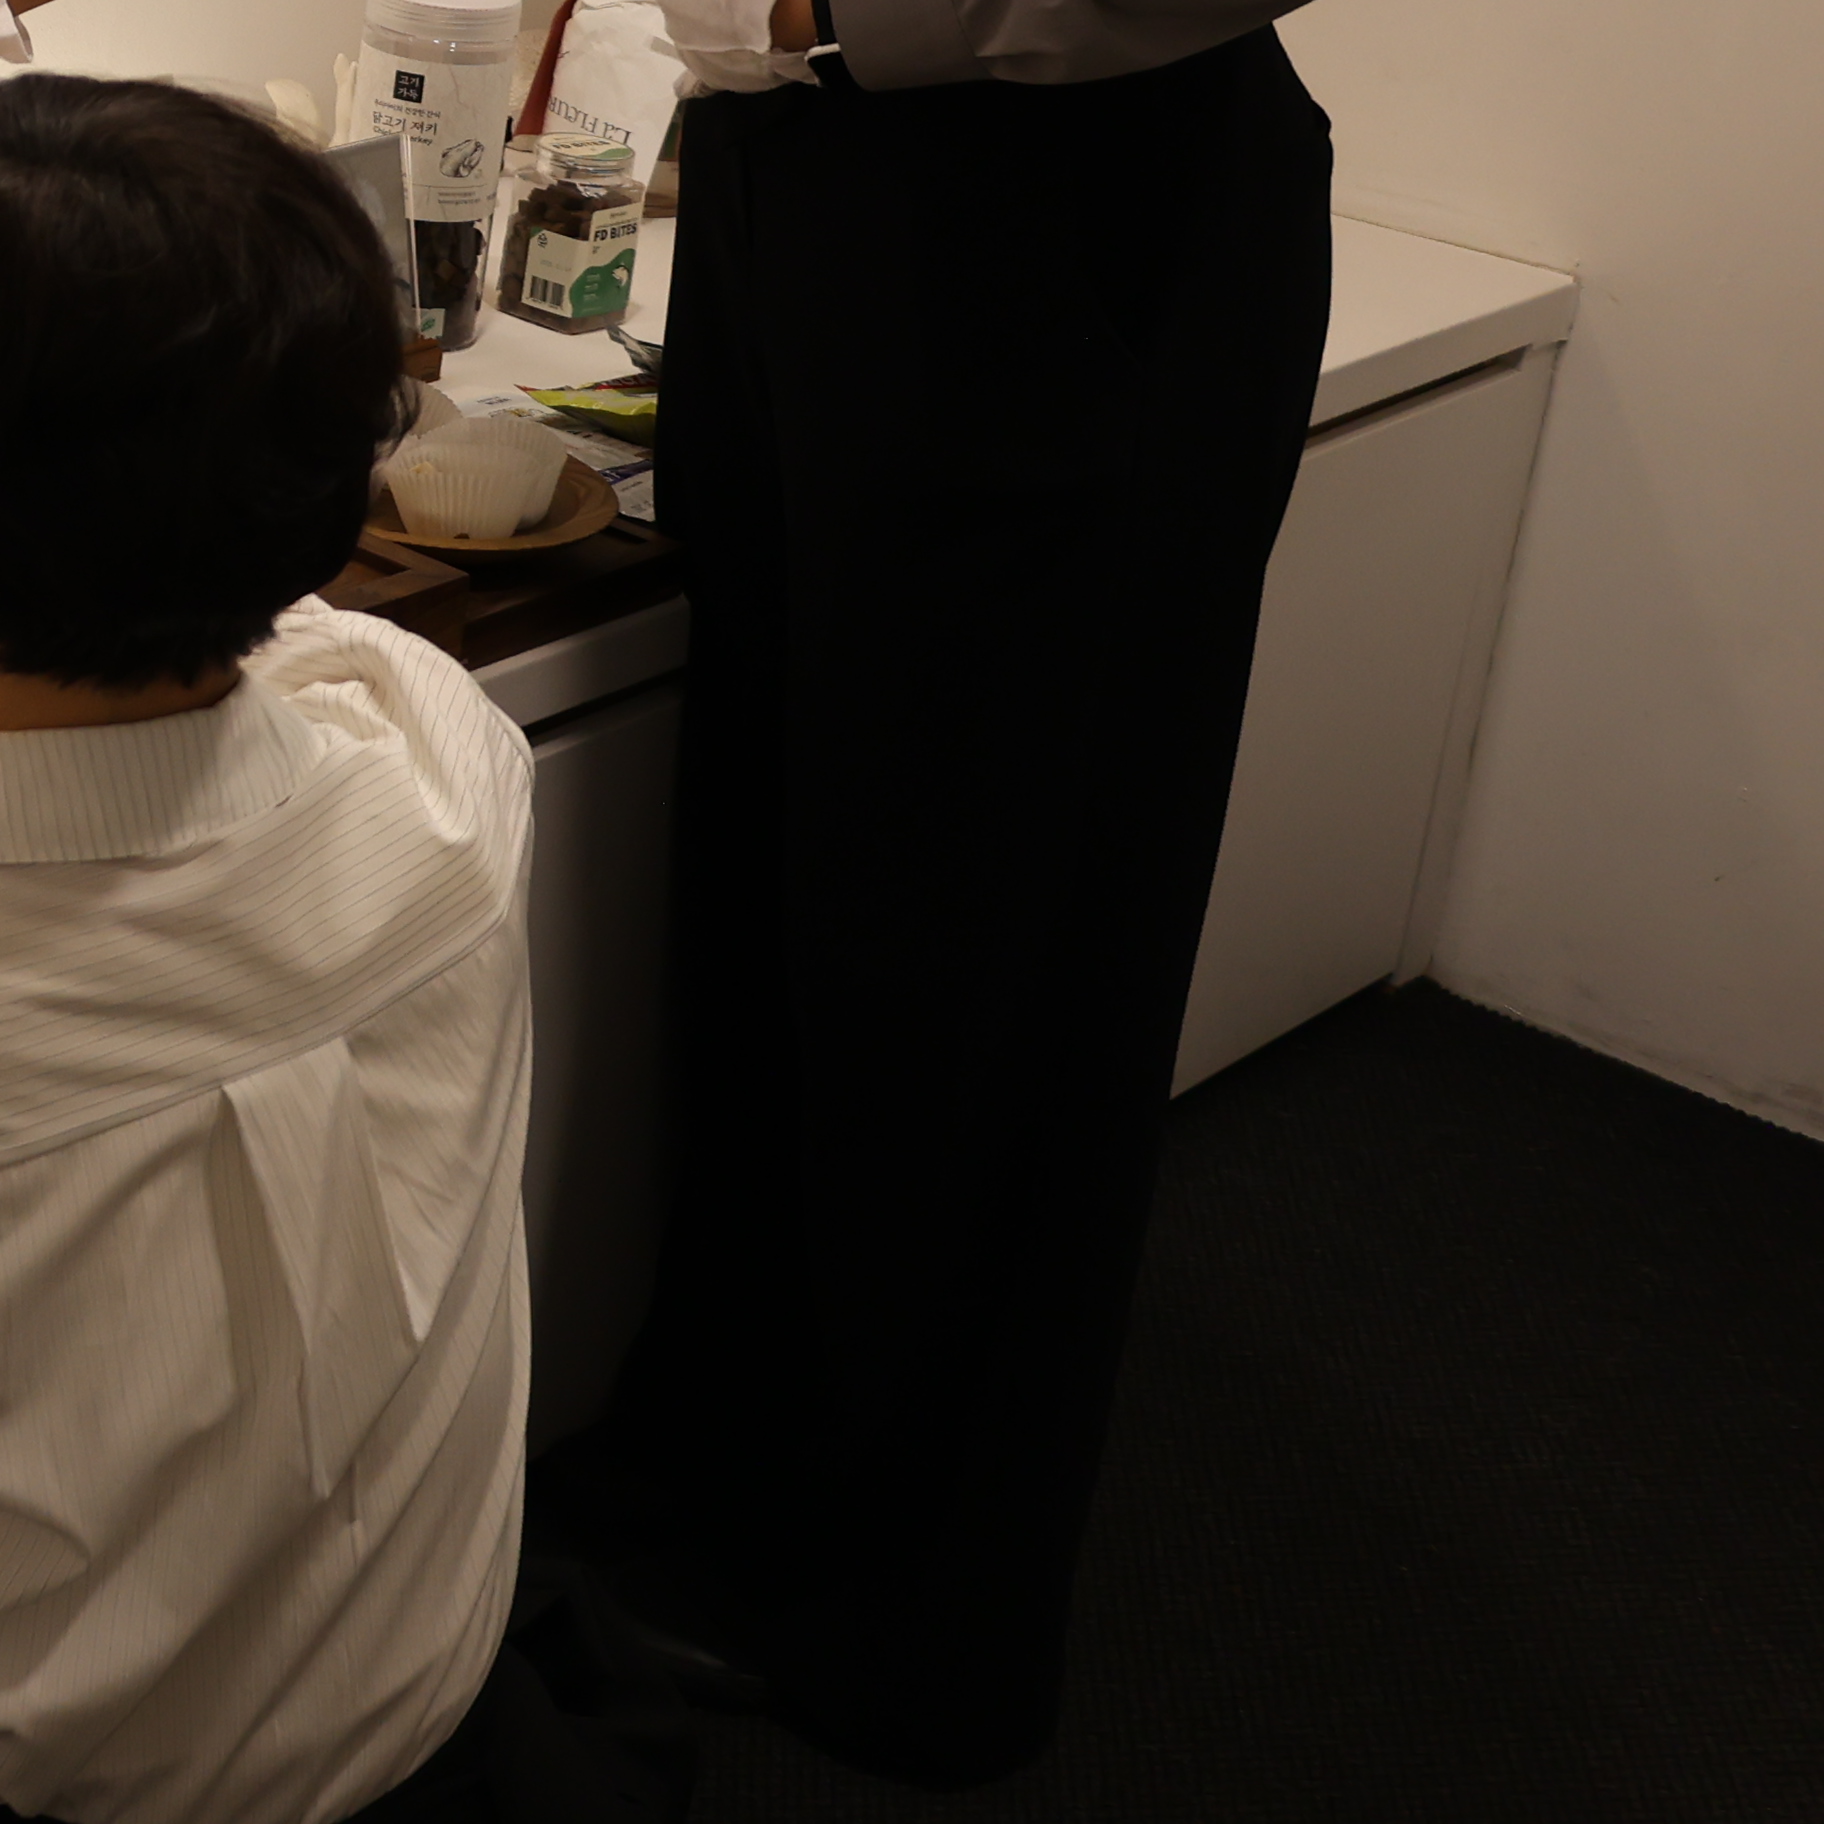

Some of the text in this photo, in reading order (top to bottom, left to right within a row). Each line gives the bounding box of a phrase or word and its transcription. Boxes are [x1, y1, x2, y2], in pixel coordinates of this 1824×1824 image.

[398, 75, 421, 88] 고기
[397, 87, 420, 100] 가득
[373, 111, 407, 132] 닭고기
[593, 229, 608, 242] FD
[610, 223, 638, 239] BITES
